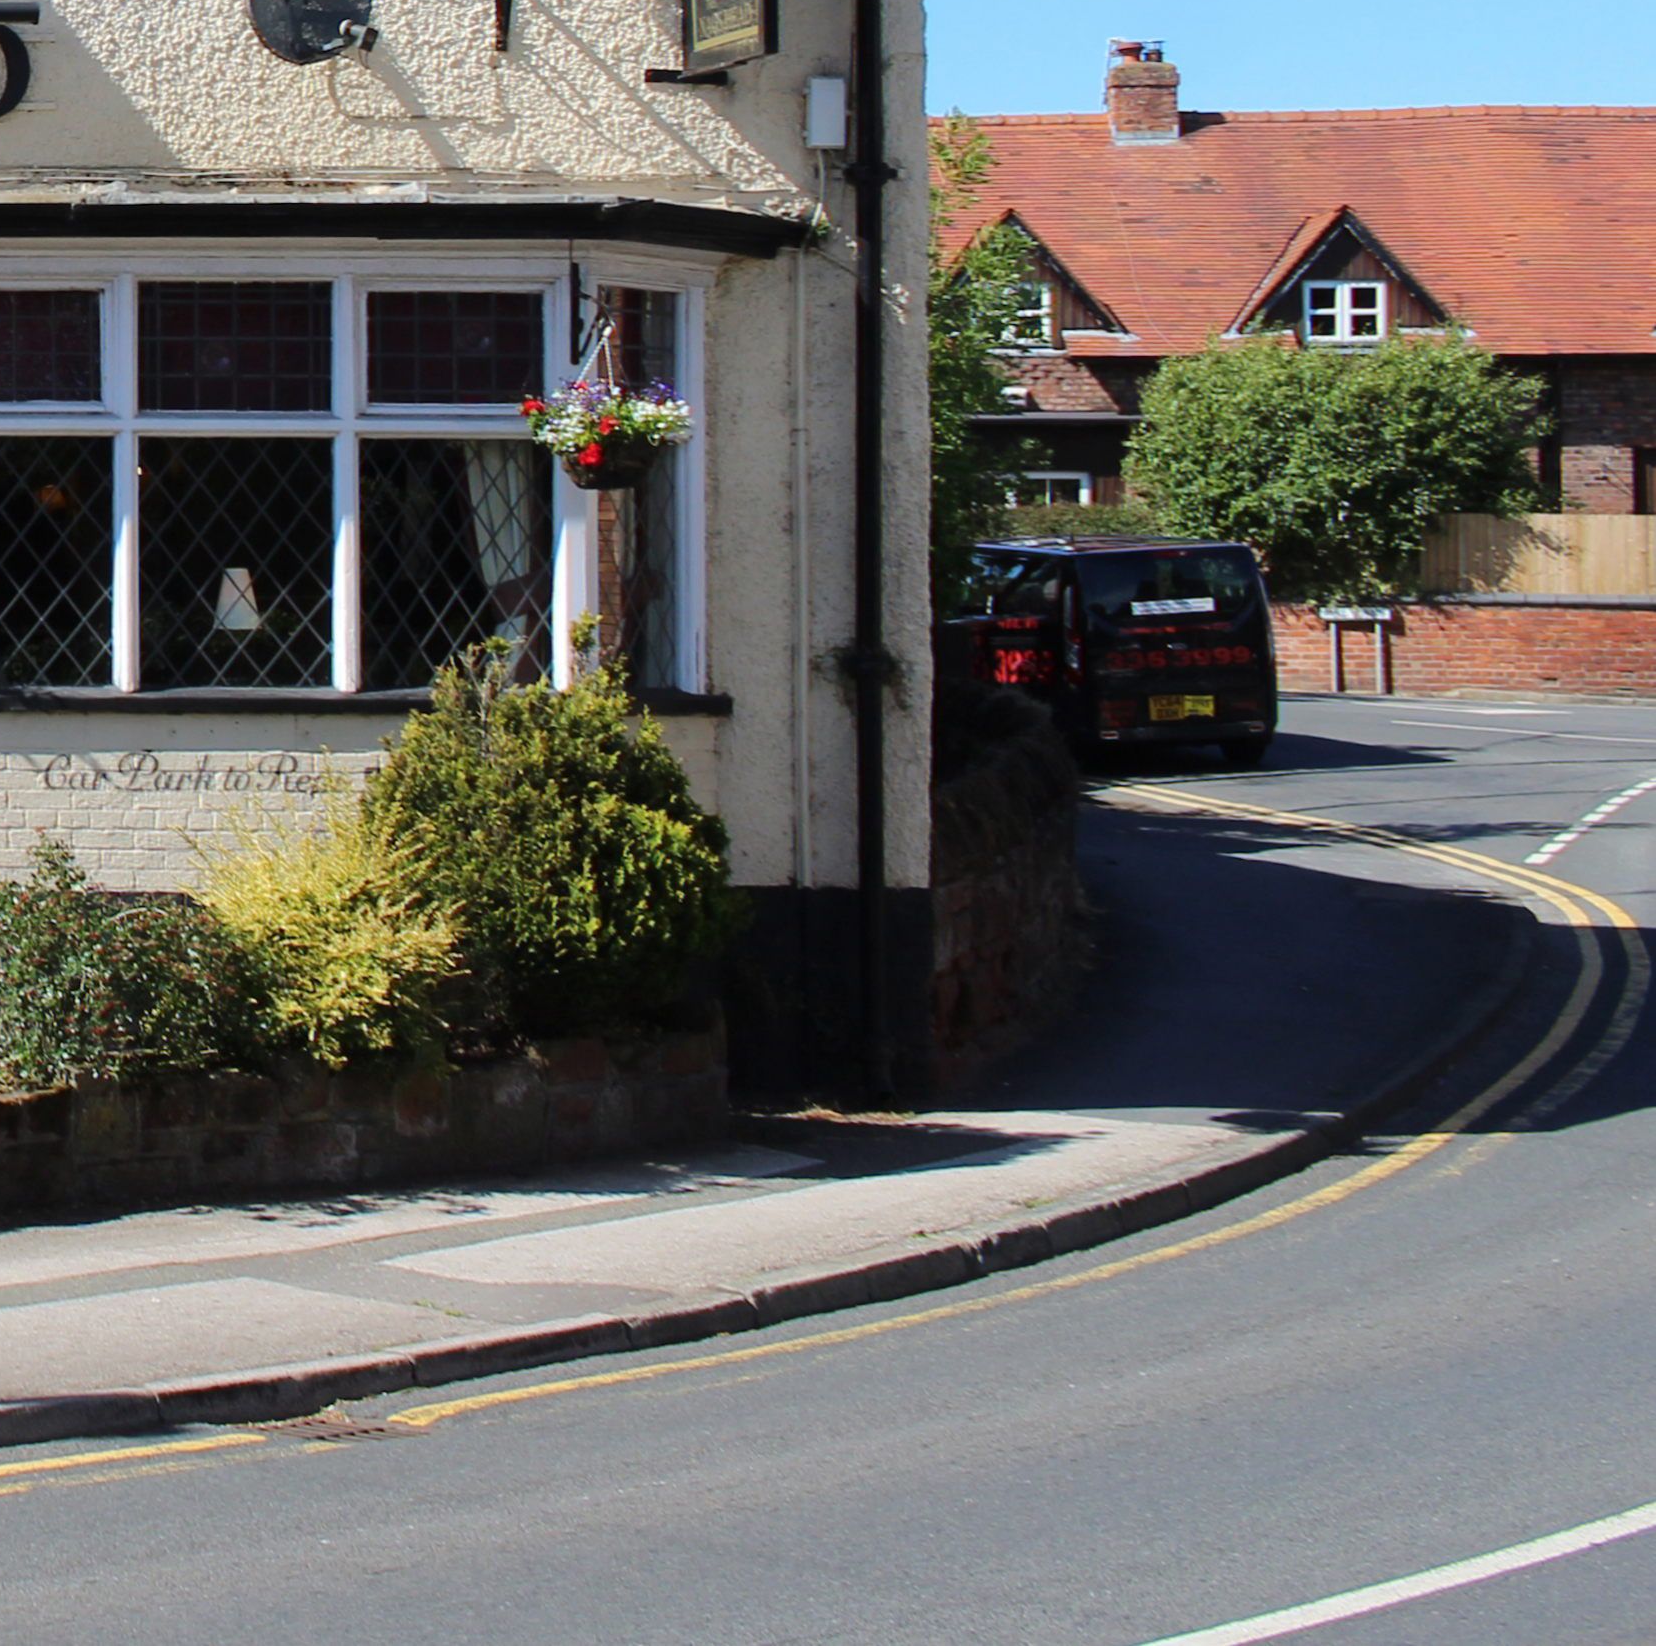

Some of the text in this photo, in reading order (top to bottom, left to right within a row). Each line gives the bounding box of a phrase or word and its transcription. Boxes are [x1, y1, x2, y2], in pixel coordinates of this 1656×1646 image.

[1105, 645, 1252, 670] 336 3999
[43, 754, 102, 790] Car
[114, 753, 212, 791] Park
[223, 765, 252, 791] to
